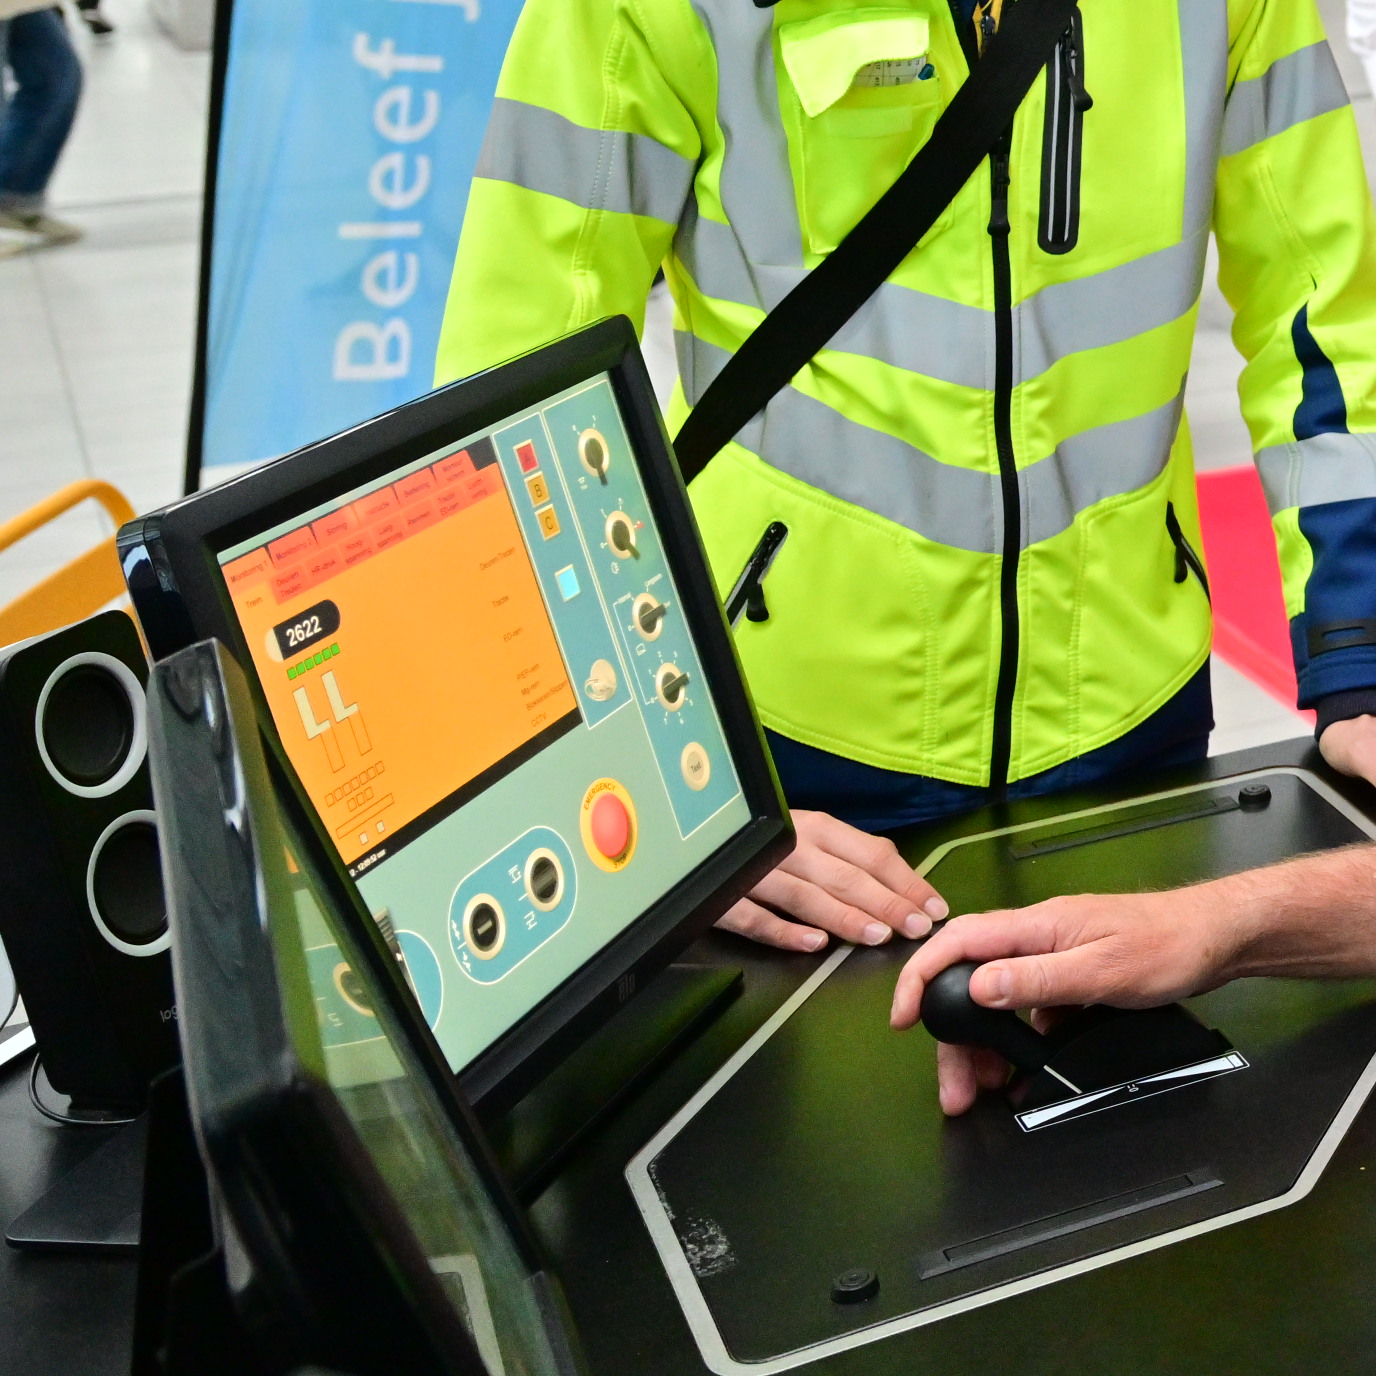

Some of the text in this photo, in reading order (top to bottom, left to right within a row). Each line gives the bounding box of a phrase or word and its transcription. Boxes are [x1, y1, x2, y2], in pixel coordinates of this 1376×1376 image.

[333, 32, 443, 382] Beleef
[534, 484, 543, 498] B
[545, 516, 554, 530] C
[230, 563, 264, 583] Monitoring
[286, 615, 322, 647] 2622
[531, 711, 547, 728] CCTV
[690, 761, 702, 774] Test
[583, 782, 616, 811] EMERGENCY
[613, 853, 628, 869] STOP
